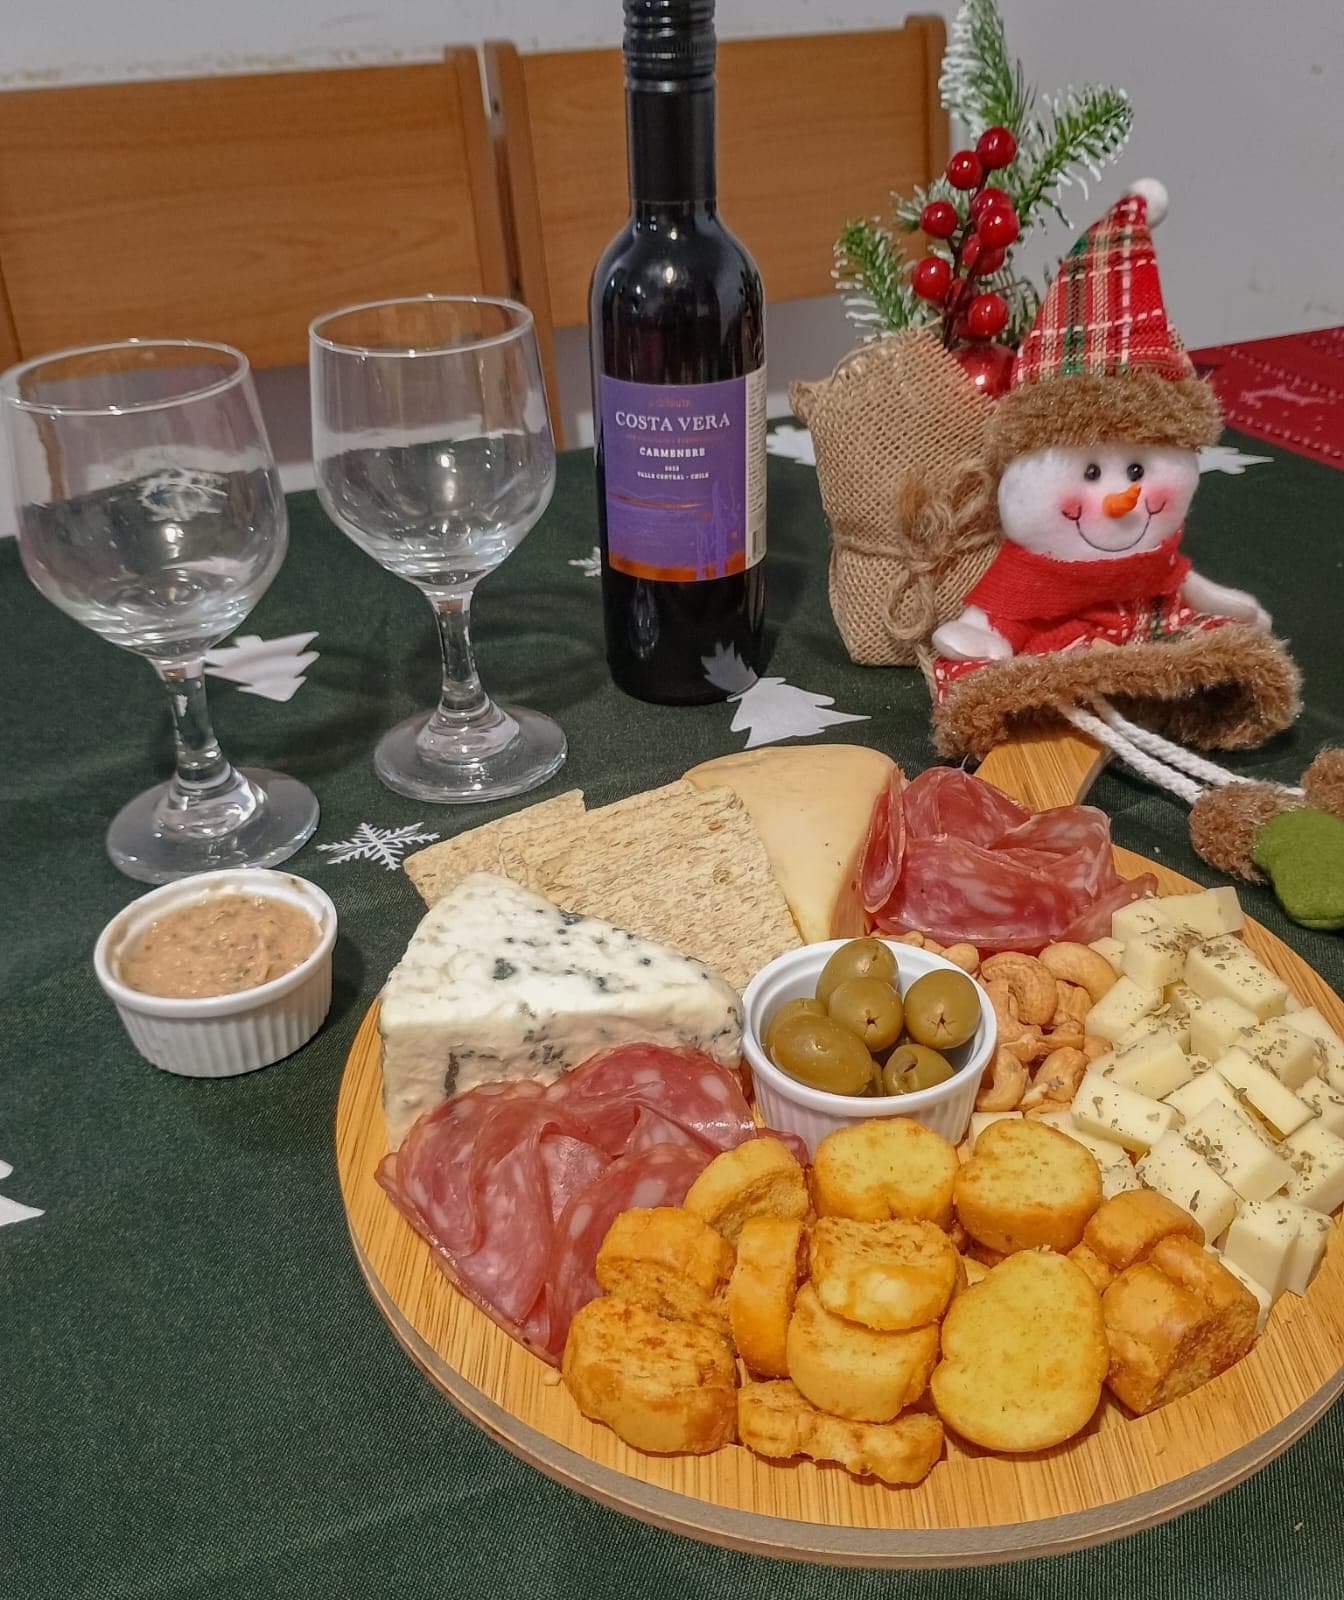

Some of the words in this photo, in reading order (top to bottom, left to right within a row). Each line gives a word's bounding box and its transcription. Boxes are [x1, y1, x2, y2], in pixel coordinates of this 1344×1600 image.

[615, 411, 673, 432] COSTA
[677, 412, 731, 432] VERA
[690, 472, 709, 480] CHILE
